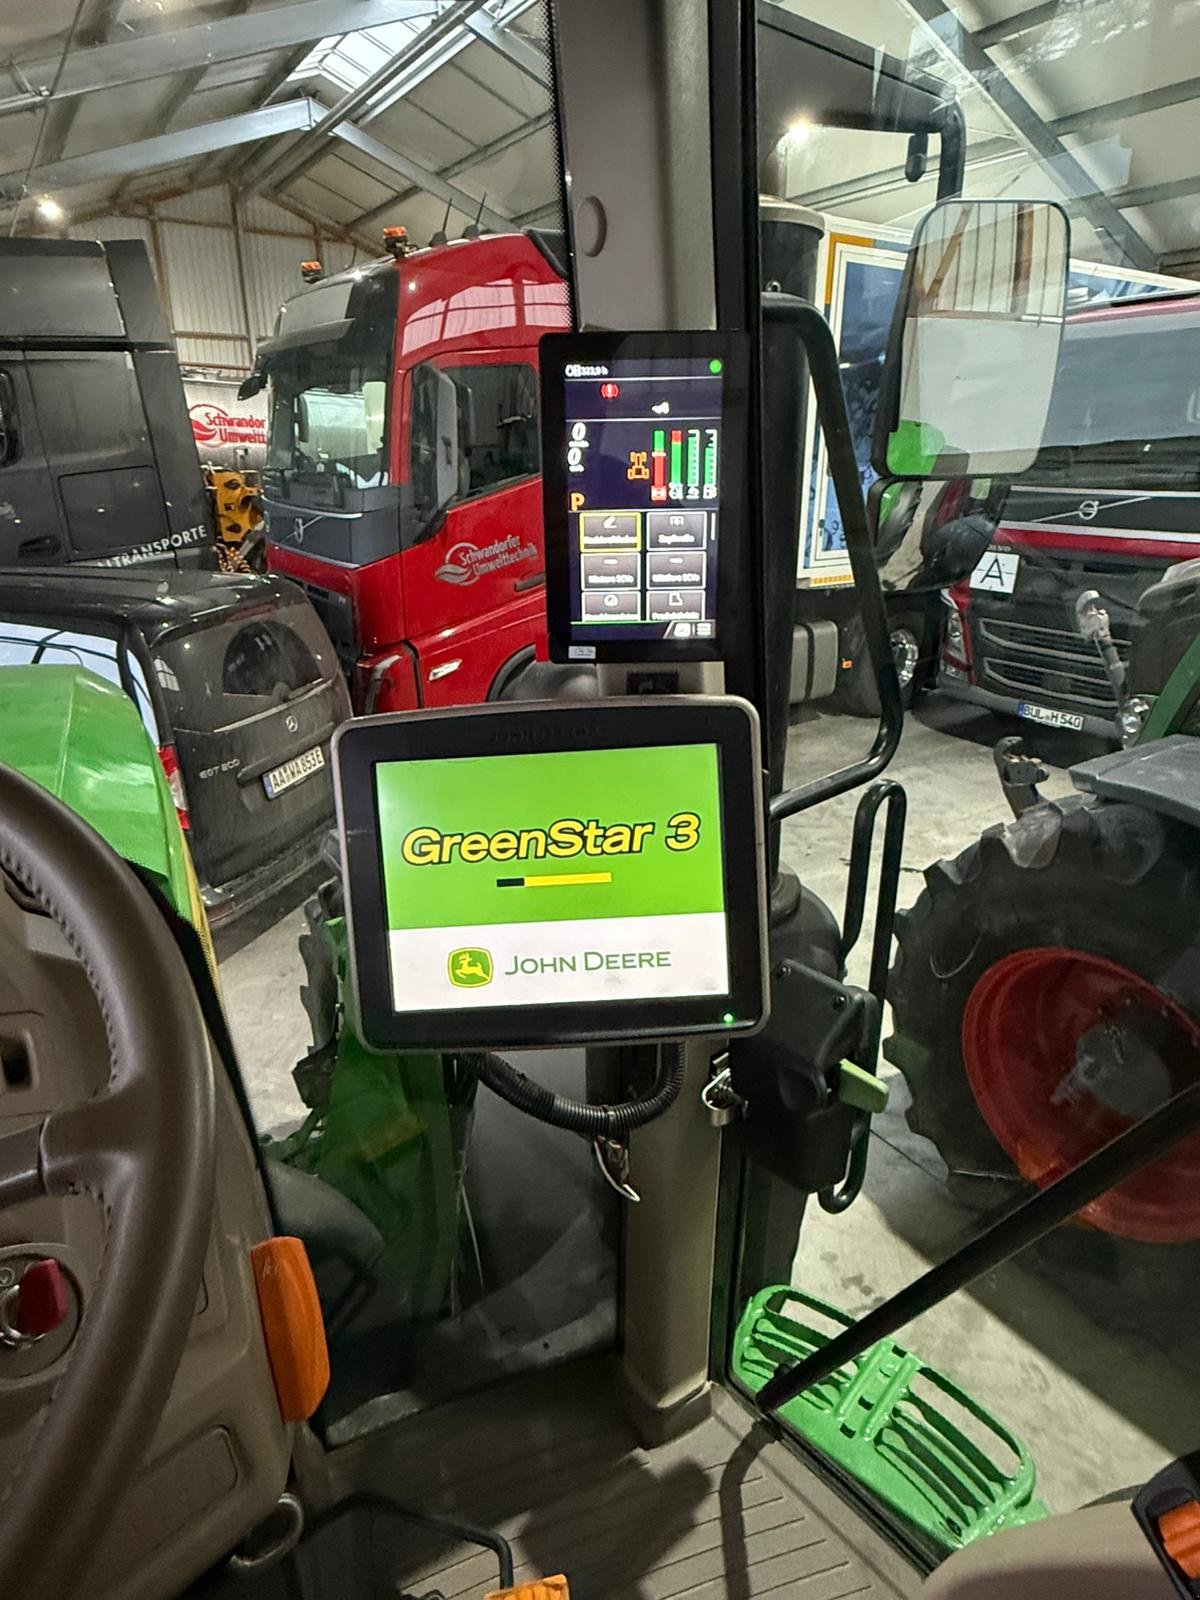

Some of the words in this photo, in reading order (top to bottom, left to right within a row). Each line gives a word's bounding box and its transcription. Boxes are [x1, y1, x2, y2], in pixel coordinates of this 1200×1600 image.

[570, 492, 585, 511] P
[980, 557, 1004, 586] A
[402, 819, 655, 866] GreenStar
[665, 811, 700, 852] 3
